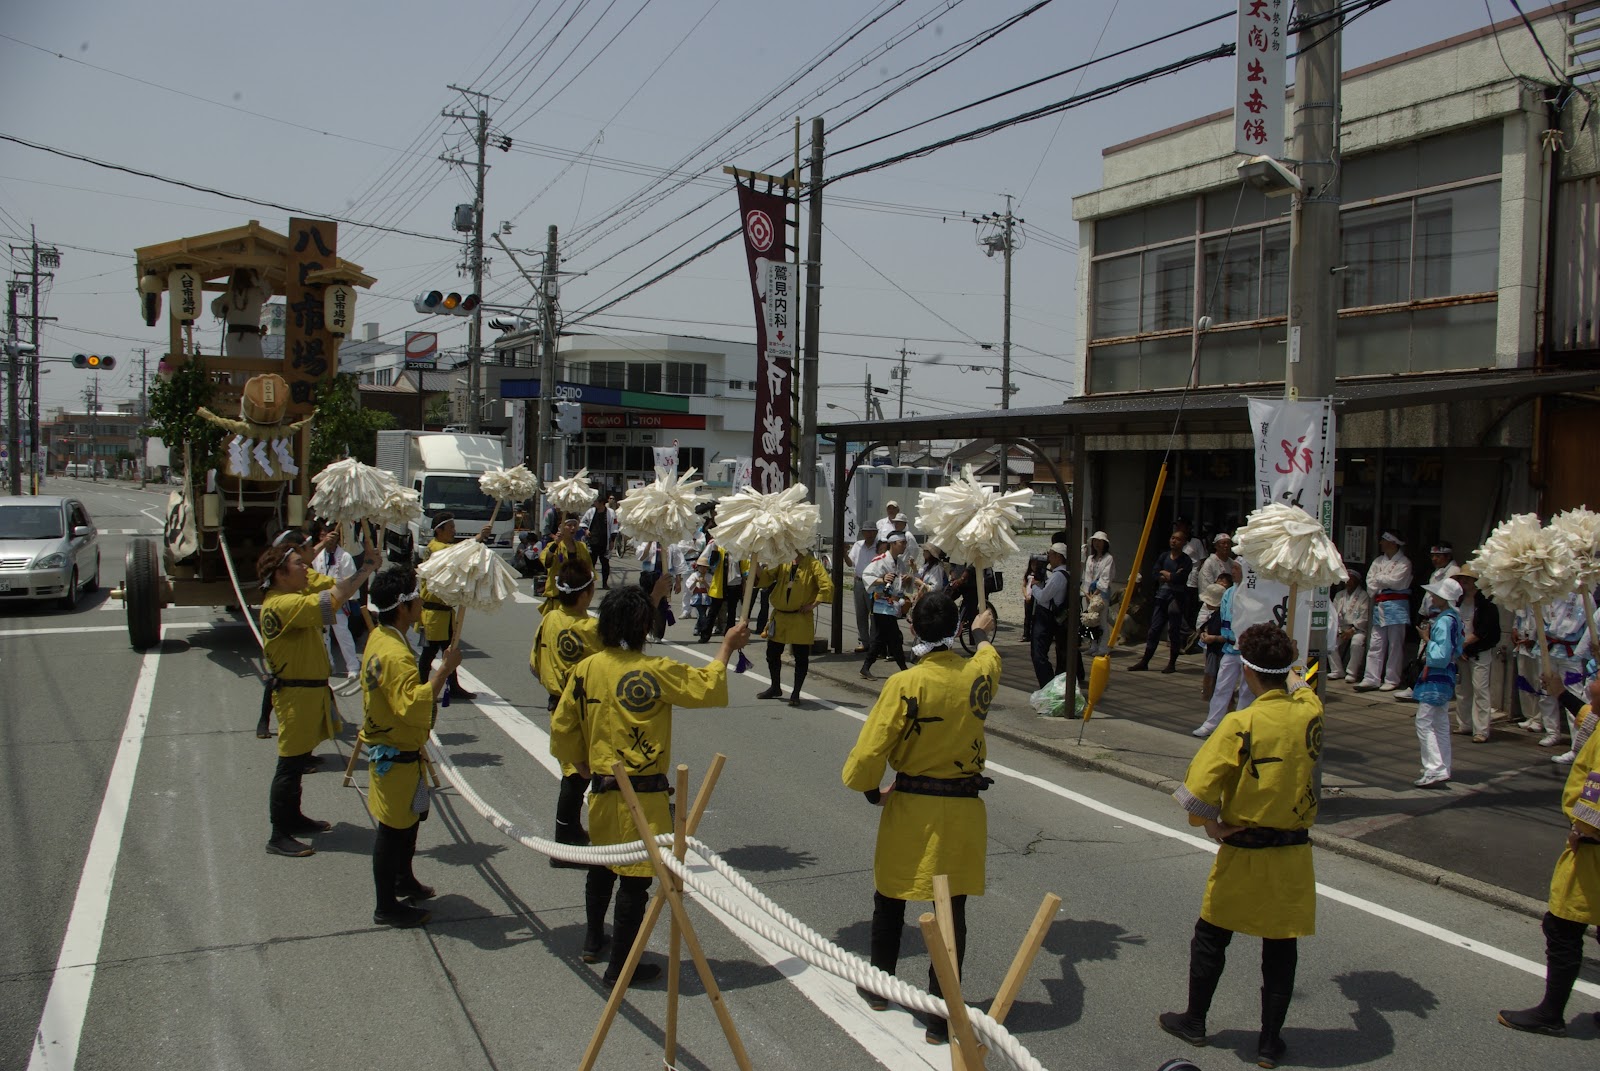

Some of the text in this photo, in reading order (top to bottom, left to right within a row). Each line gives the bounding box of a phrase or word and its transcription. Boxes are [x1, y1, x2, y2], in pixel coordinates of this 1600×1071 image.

[180, 272, 196, 316] 八日市場町
[333, 286, 348, 328] 八日市場町
[774, 265, 788, 329] 鷲見内科
